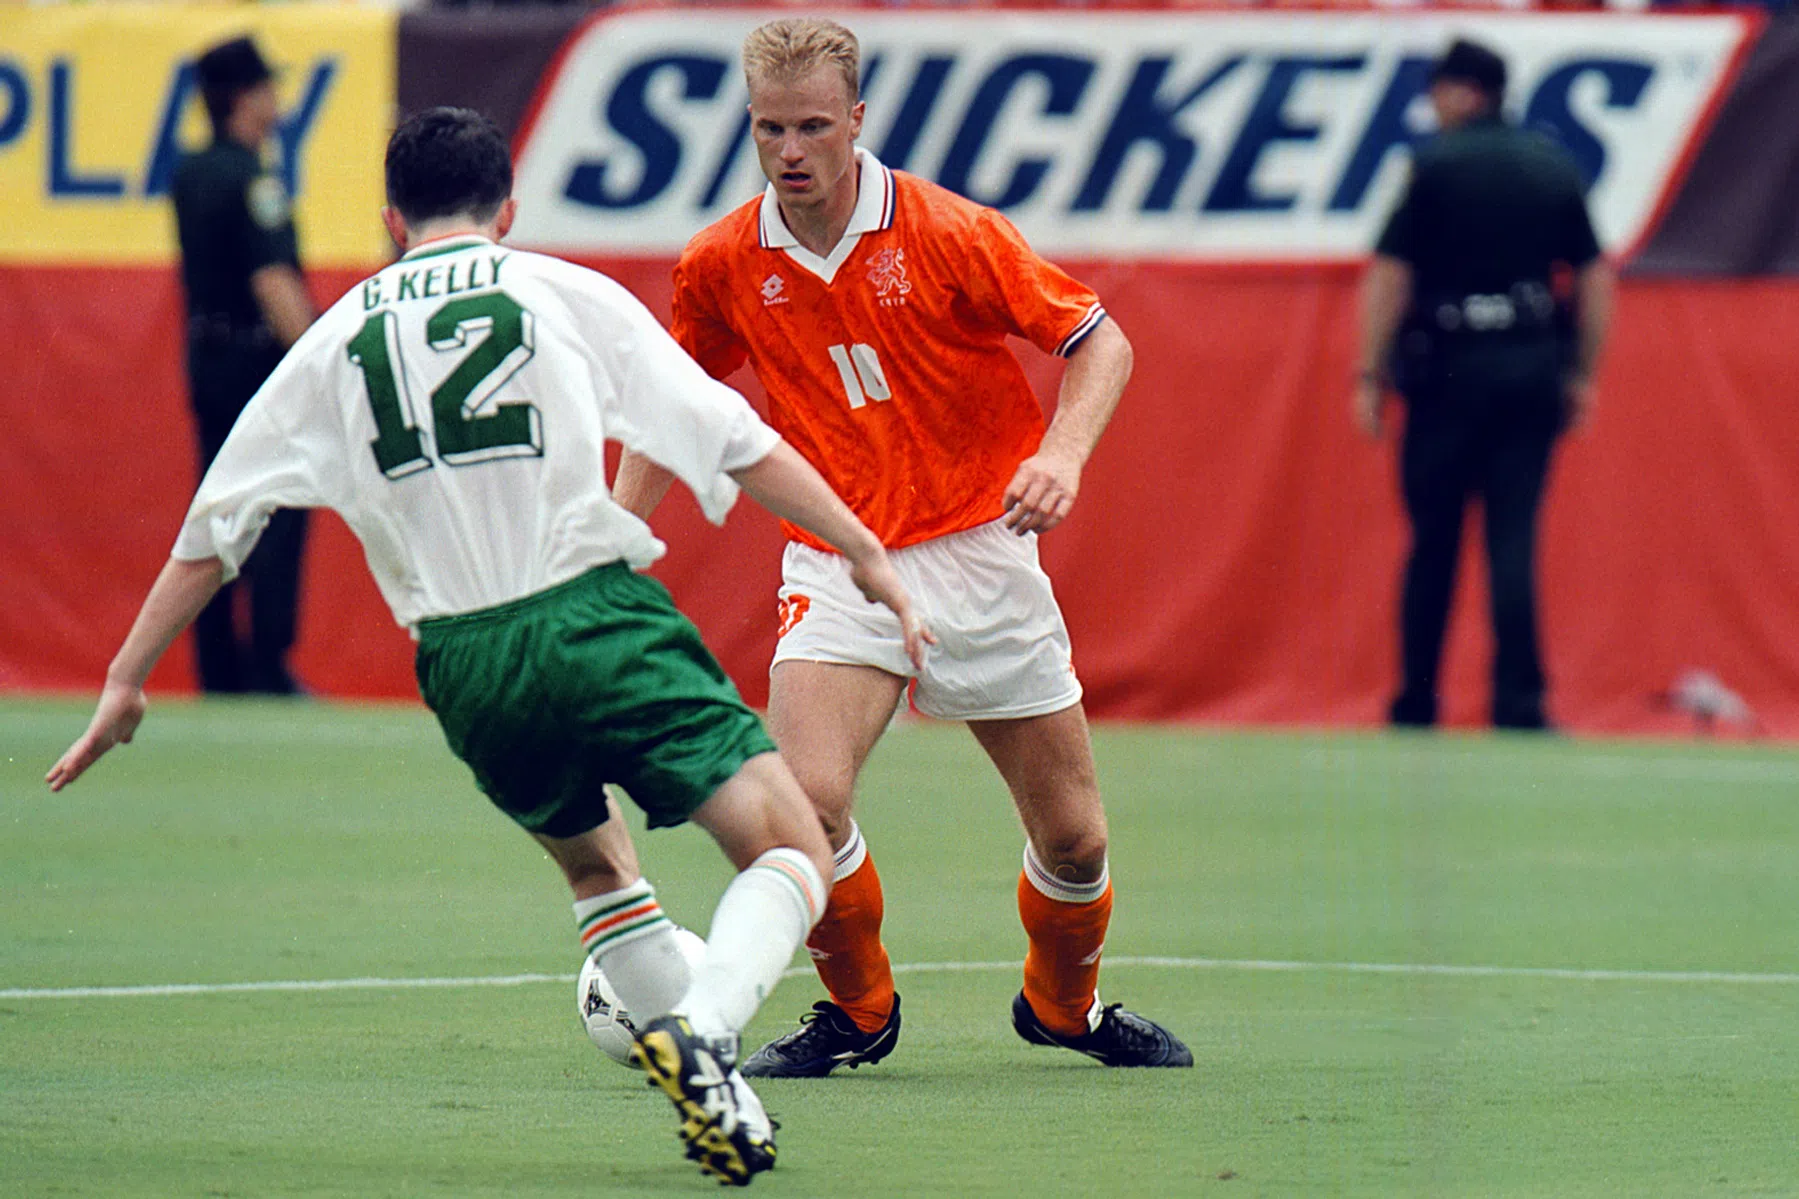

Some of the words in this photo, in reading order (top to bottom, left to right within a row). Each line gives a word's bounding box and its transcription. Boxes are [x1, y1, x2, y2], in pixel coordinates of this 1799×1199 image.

[397, 252, 511, 302] KELLY
[346, 288, 545, 481] 12
[828, 342, 892, 410] 10
